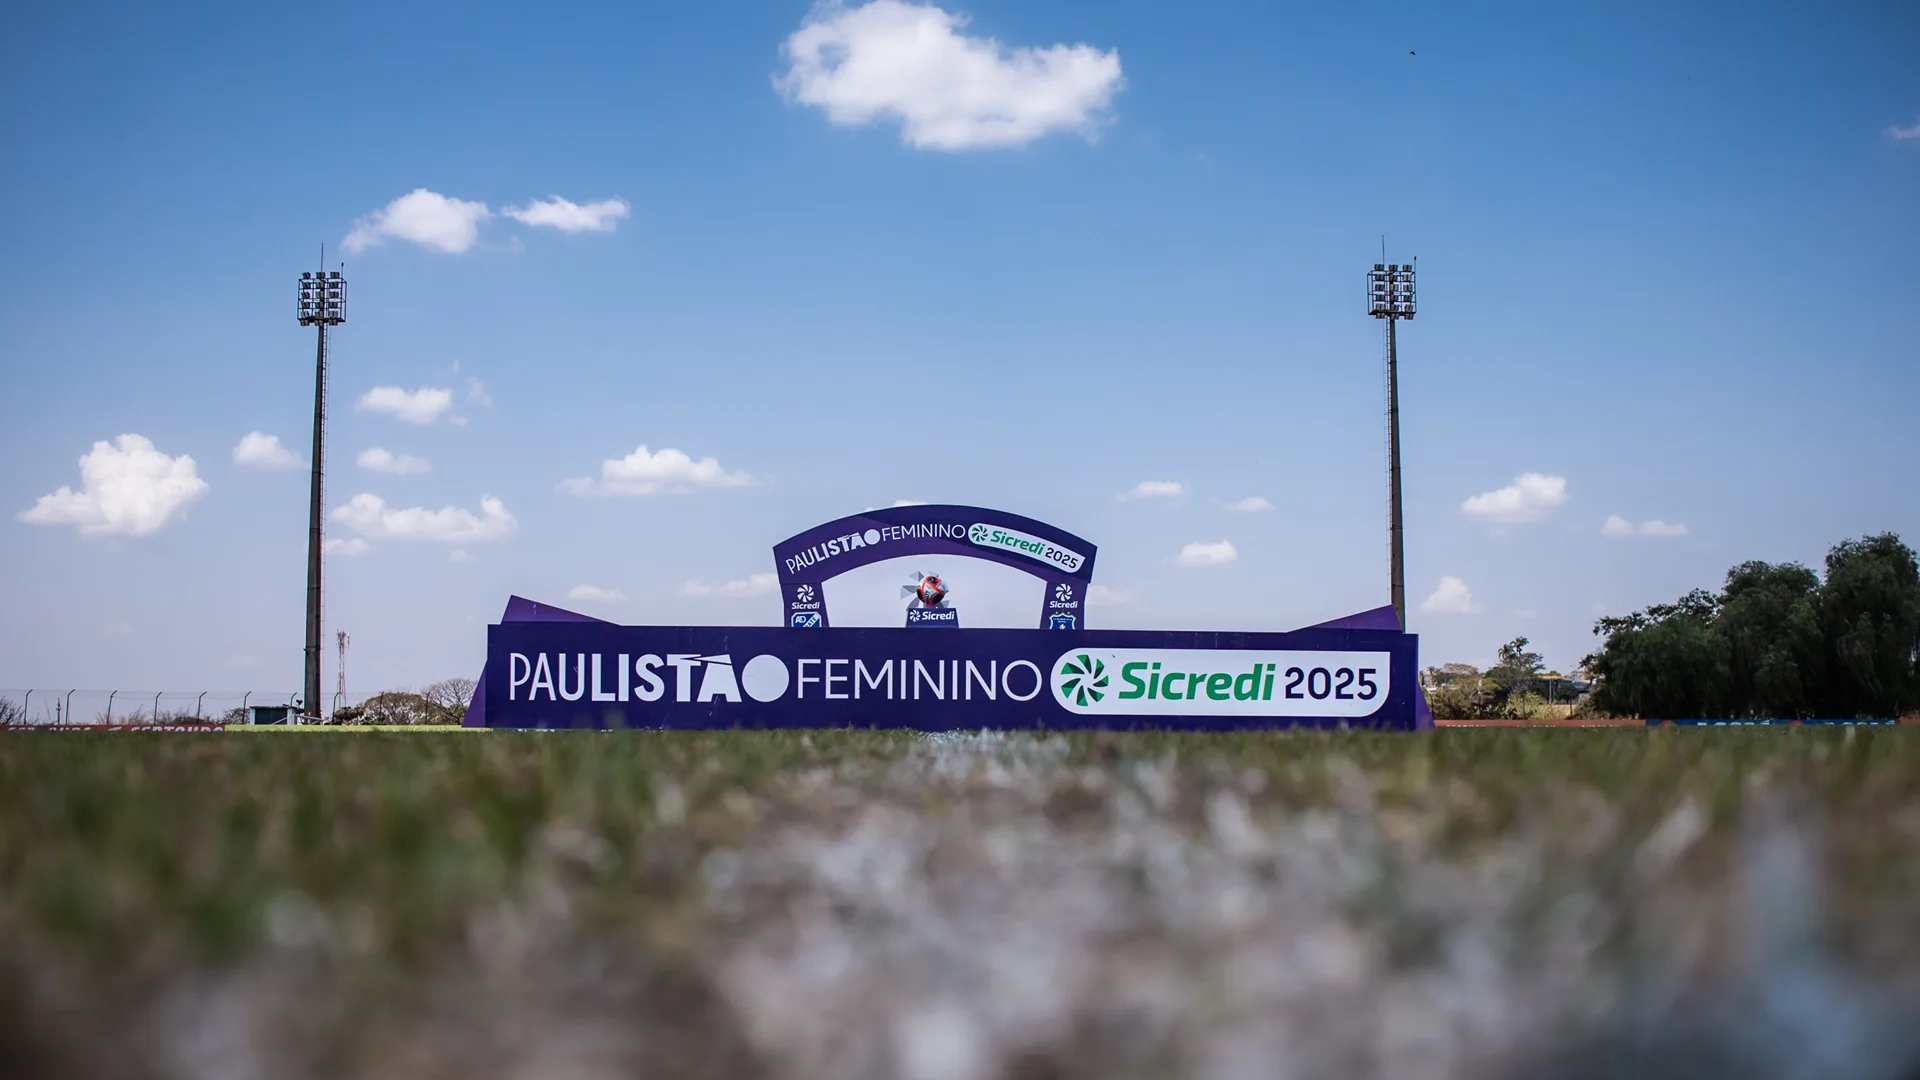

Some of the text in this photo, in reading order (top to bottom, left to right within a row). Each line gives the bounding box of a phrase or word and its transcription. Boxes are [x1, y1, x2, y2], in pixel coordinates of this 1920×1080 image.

[882, 524, 966, 542] FEMININO
[990, 530, 1046, 555] Sicredi
[1045, 547, 1079, 569] 2025
[791, 601, 820, 610] Sicredi
[1049, 600, 1078, 609] Sicredi
[921, 611, 955, 620] Sicredi
[797, 659, 1043, 702] FEMININO
[1118, 661, 1276, 701] Sicredi
[1284, 667, 1378, 701] 2025
